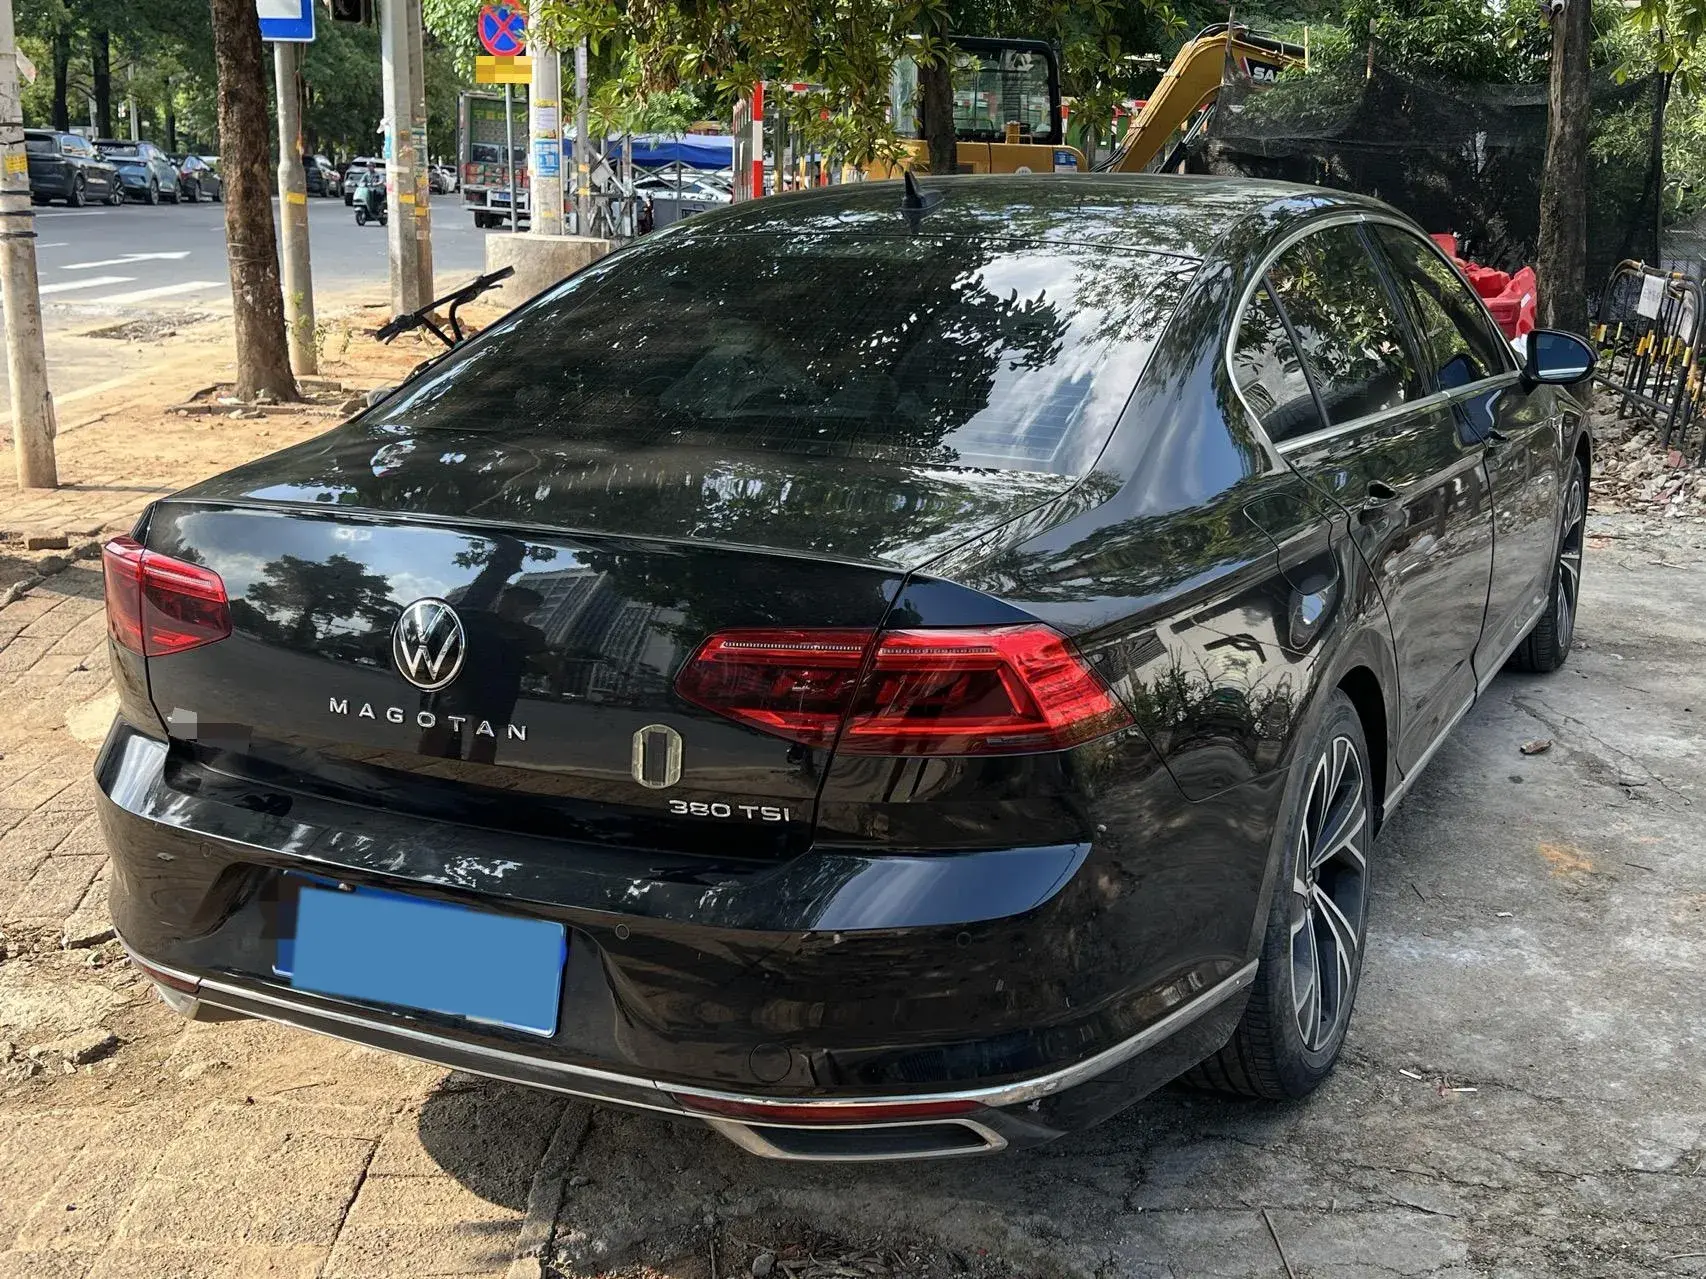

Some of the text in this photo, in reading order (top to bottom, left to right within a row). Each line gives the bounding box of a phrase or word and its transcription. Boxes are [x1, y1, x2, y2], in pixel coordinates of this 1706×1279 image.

[329, 697, 527, 741] MAGOTAN
[669, 799, 790, 822] 380 TSI
